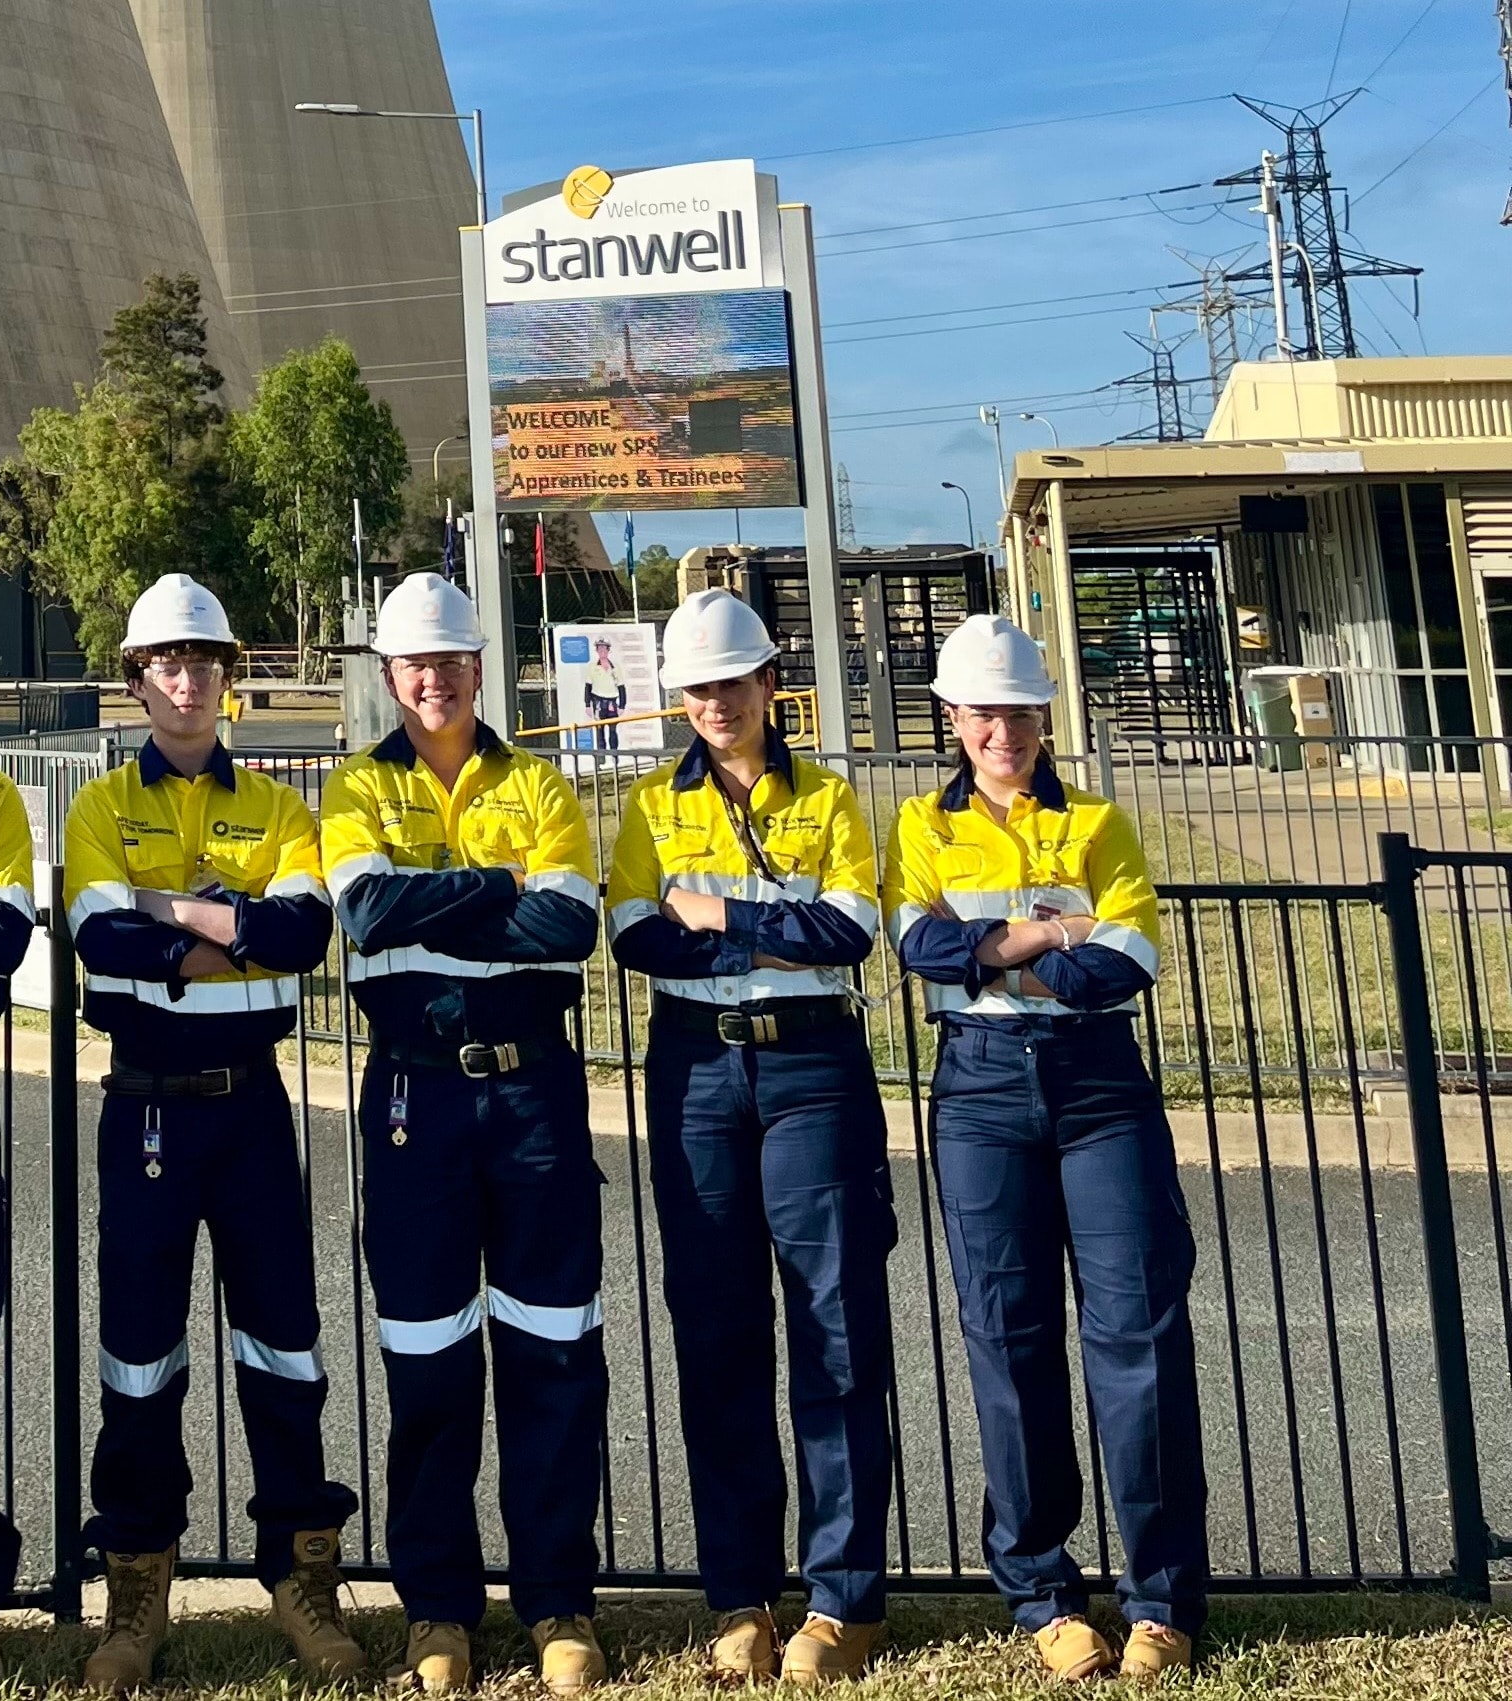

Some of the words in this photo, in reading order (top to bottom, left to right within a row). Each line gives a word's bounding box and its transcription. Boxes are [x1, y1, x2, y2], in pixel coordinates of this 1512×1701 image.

[606, 200, 687, 218] Welcome
[692, 198, 710, 212] to
[501, 209, 746, 284] stanwell
[507, 409, 611, 429] WELCOME
[510, 443, 529, 460] to
[536, 443, 569, 459] our
[575, 442, 617, 458] new
[511, 470, 629, 493] Apprentices
[636, 470, 652, 487] &
[655, 468, 744, 487] Trainees
